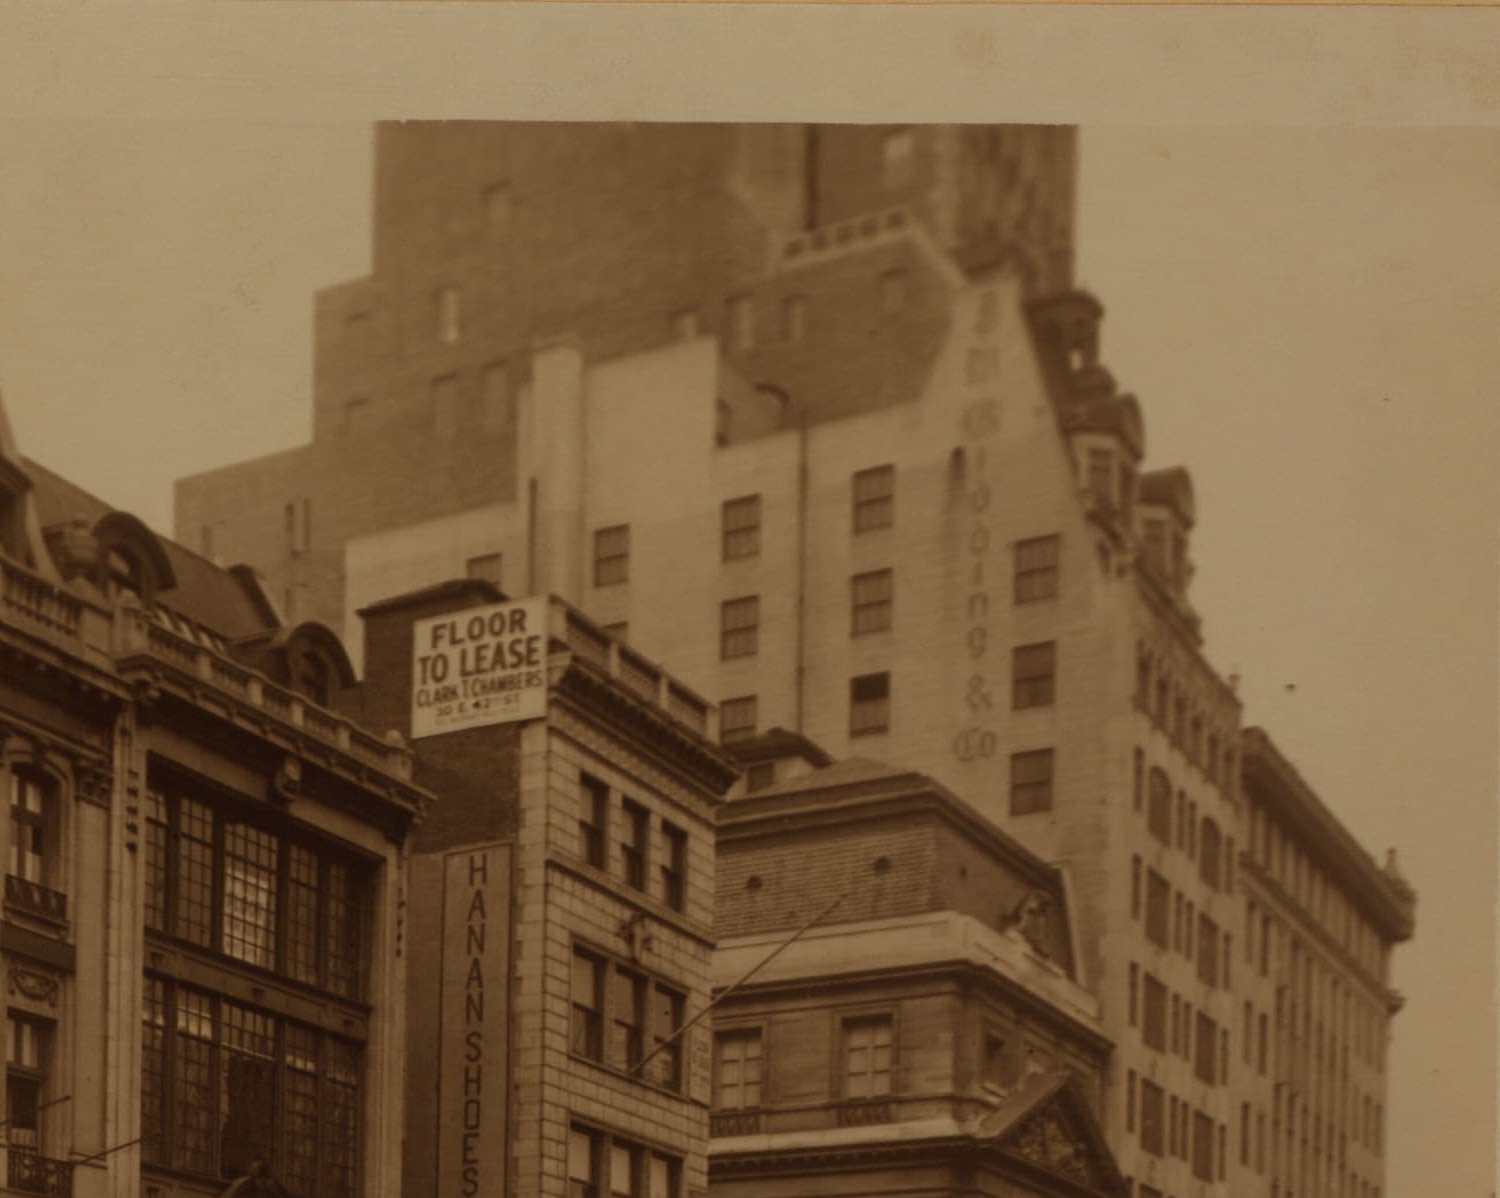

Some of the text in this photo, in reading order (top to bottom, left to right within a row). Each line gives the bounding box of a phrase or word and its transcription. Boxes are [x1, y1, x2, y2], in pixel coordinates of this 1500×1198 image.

[431, 608, 527, 650] FLOOR
[418, 635, 541, 686] TO LEASE
[416, 685, 459, 708] CLARK
[471, 670, 543, 698] CHAMBERS
[461, 852, 488, 1198] HANAN SHOES
